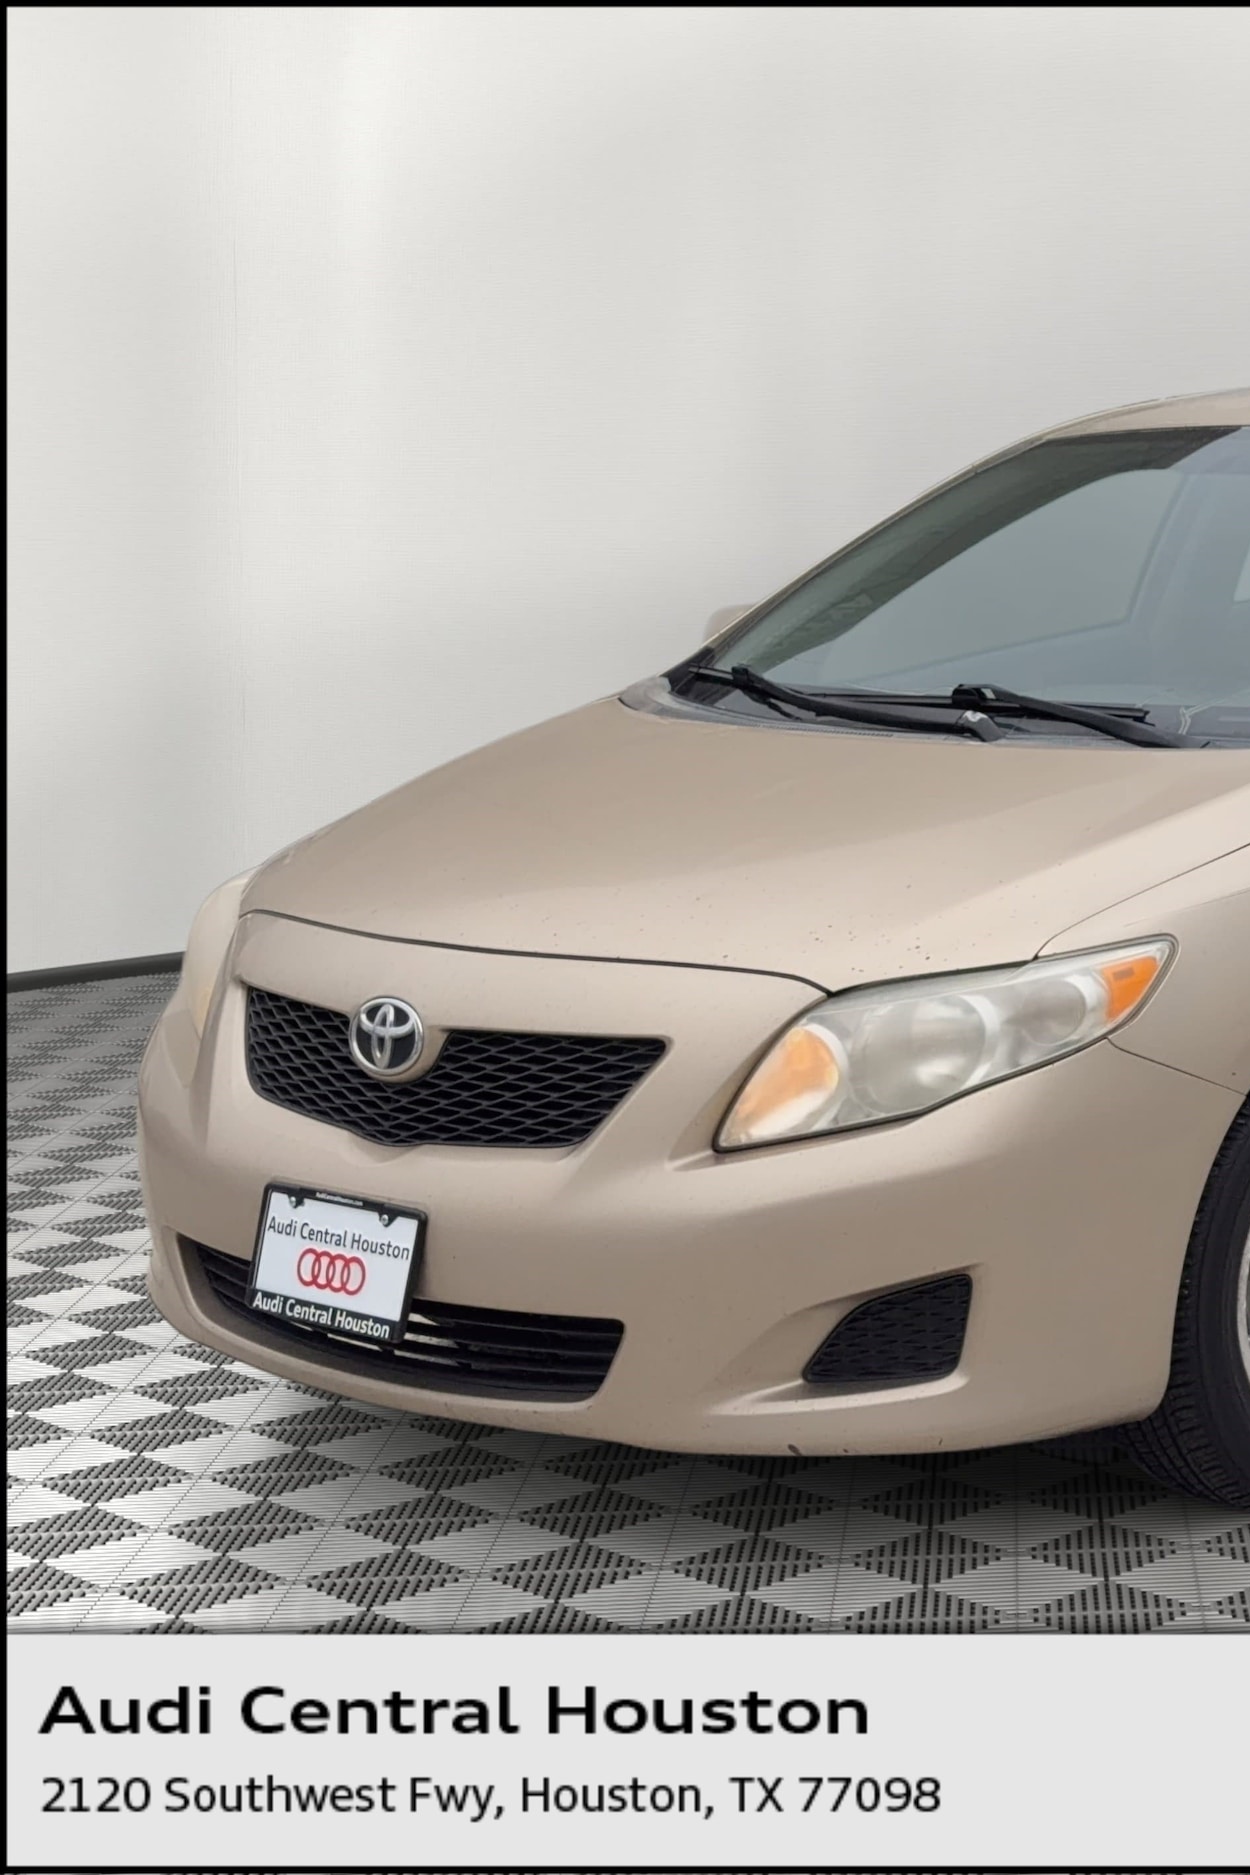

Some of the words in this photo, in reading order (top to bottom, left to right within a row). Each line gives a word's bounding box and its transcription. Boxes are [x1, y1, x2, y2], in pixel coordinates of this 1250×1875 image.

[268, 1215, 297, 1237] Audi
[300, 1222, 347, 1248] Central
[351, 1233, 410, 1260] Houston
[253, 1292, 283, 1314] Audi
[285, 1299, 332, 1325] Central
[335, 1310, 390, 1338] Houston
